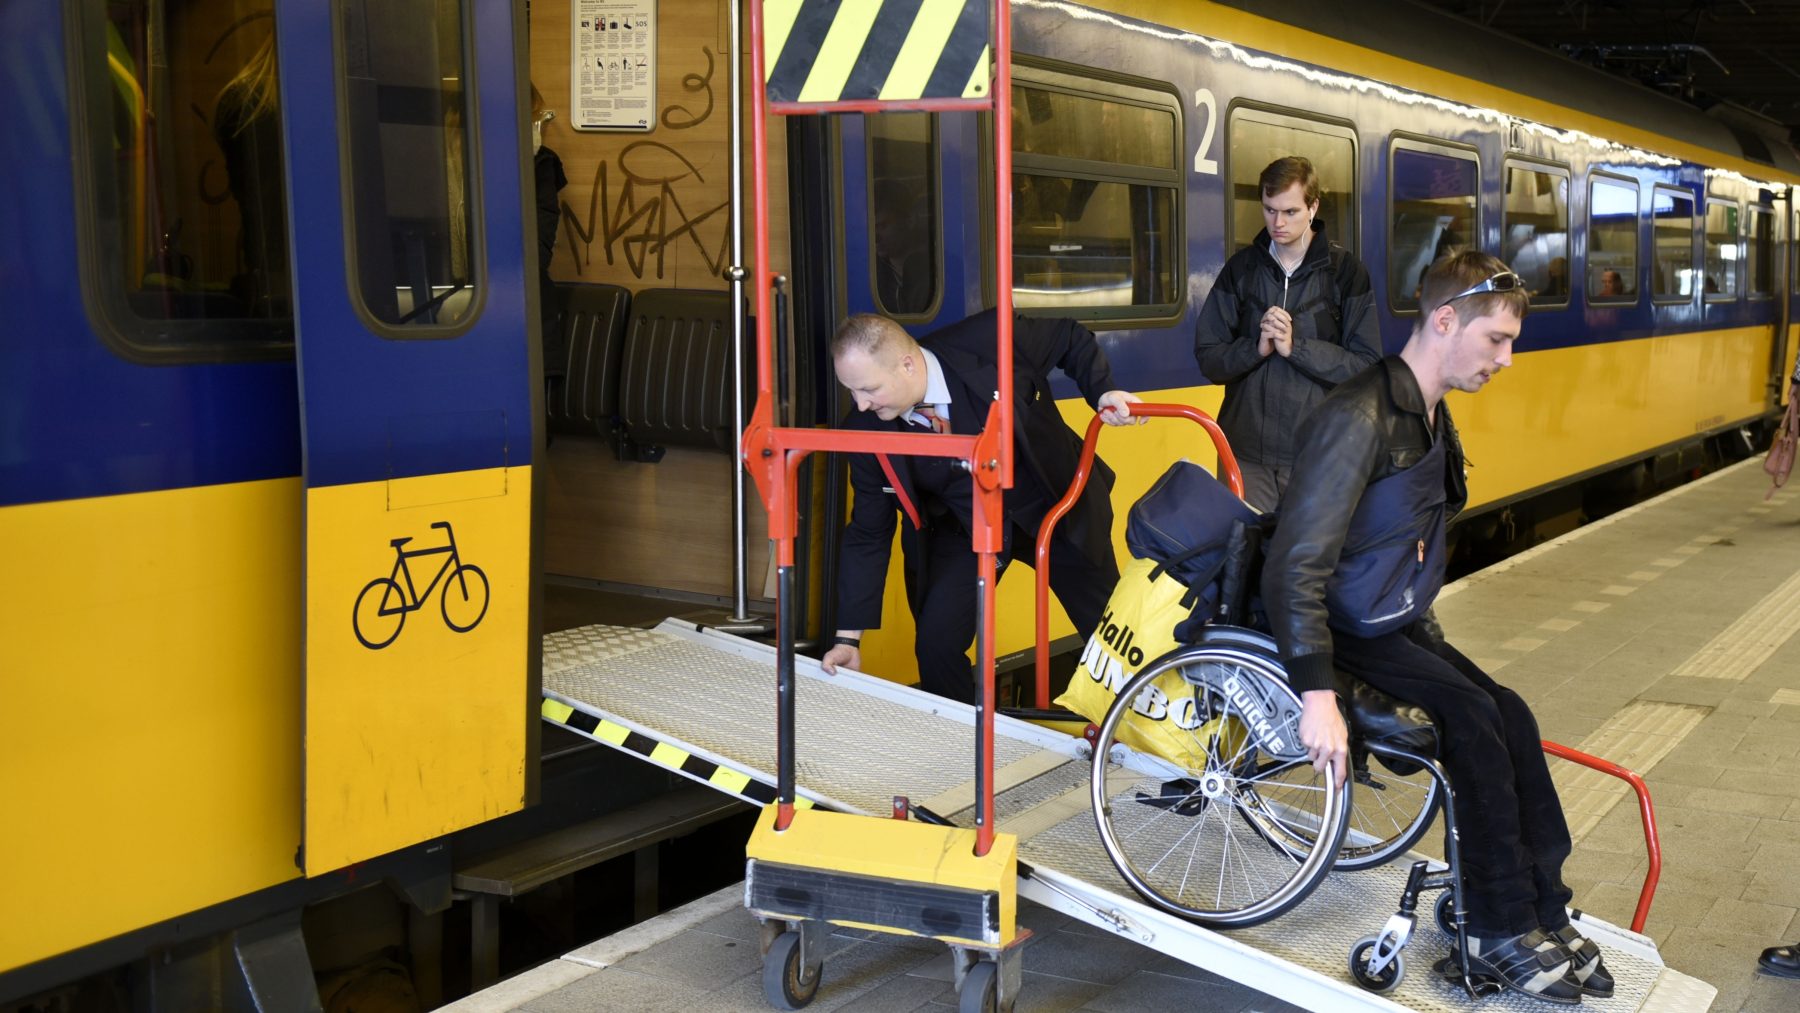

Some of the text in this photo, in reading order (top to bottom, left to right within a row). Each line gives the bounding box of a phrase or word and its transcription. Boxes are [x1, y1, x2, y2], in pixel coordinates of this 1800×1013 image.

[1194, 88, 1218, 175] 2
[1099, 606, 1144, 667] Hallo
[1223, 677, 1285, 755] QUICKIE
